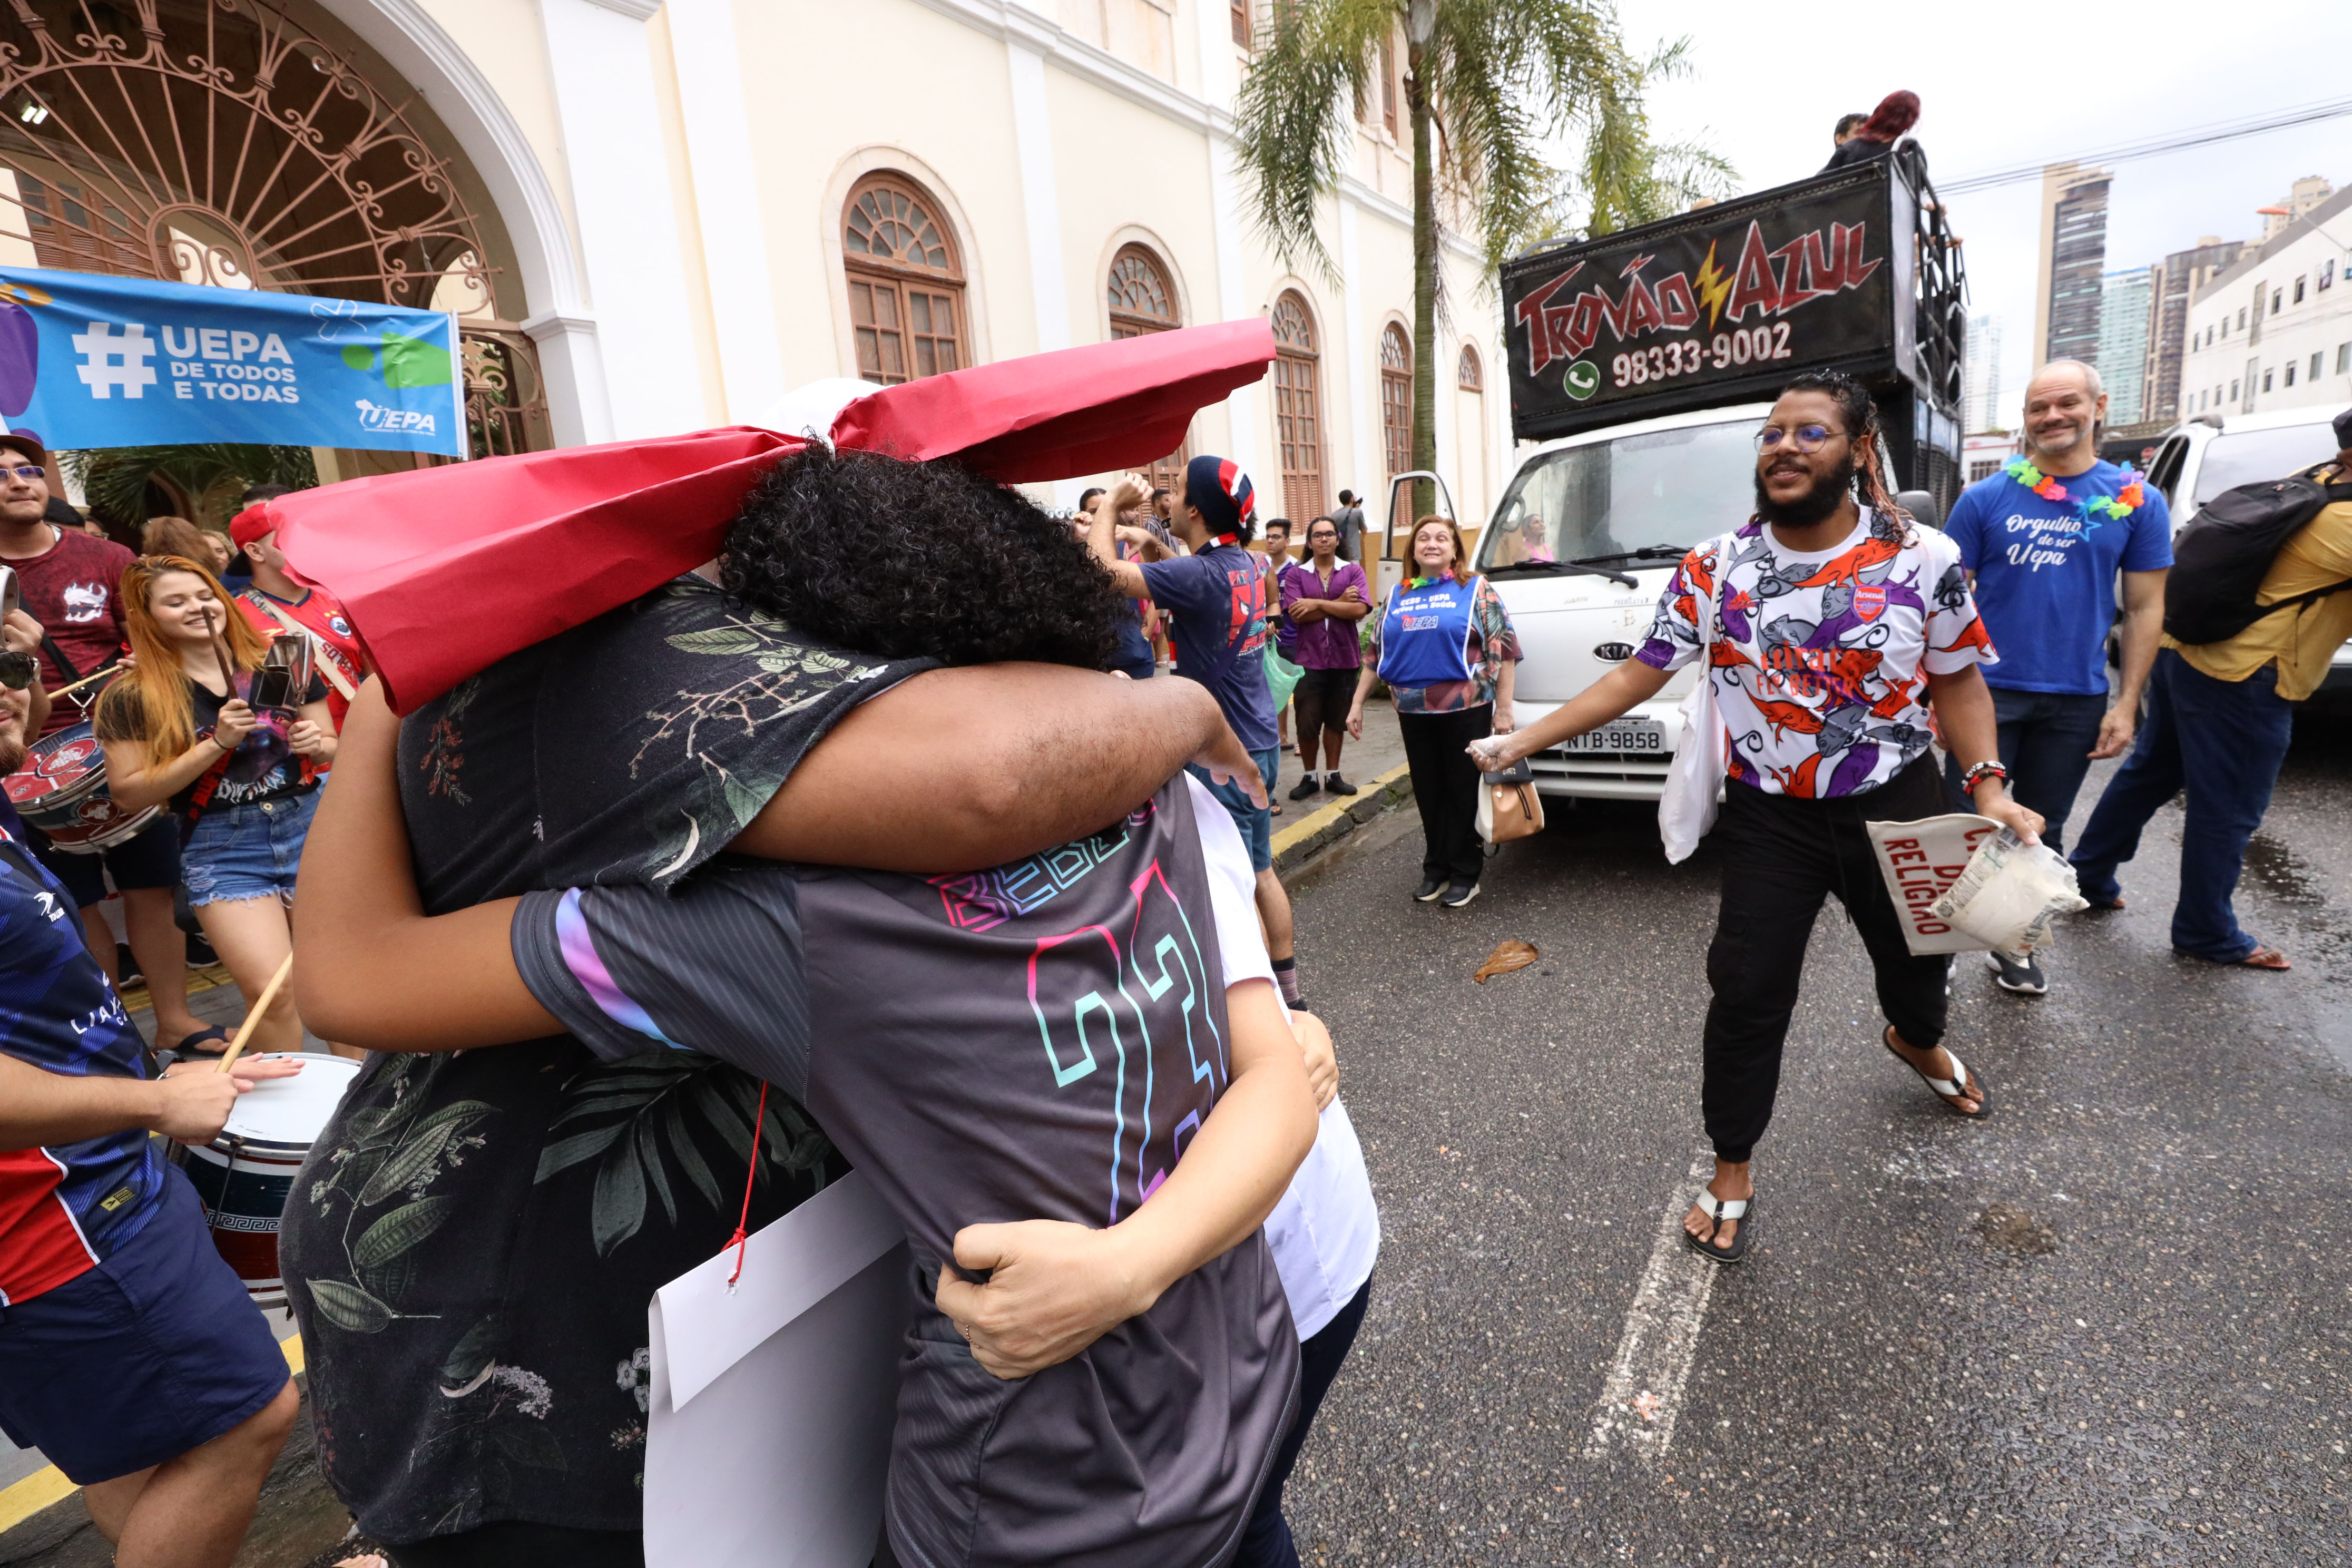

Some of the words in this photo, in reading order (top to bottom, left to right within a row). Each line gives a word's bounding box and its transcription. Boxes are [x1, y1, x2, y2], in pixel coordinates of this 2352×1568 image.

[1514, 253, 1700, 377] TROVÃO
[1725, 219, 1884, 323] AZUL
[1612, 320, 1791, 388] 98333-9002
[170, 361, 205, 378] DE
[210, 364, 296, 383] TODOS
[174, 381, 194, 399] E
[199, 382, 299, 404] TODAS
[356, 403, 436, 432] UEPA
[2005, 514, 2082, 538] Orgulho
[2037, 533, 2054, 546] de
[2055, 538, 2076, 547] ser
[2006, 543, 2067, 572] Uepa
[1428, 593, 1451, 602] UEPA
[1856, 591, 1884, 599] Arsenal
[1402, 615, 1439, 629] UEPA
[1600, 645, 1631, 659] KIA
[1756, 674, 1782, 696] FLY
[1789, 673, 1856, 699] BETTER
